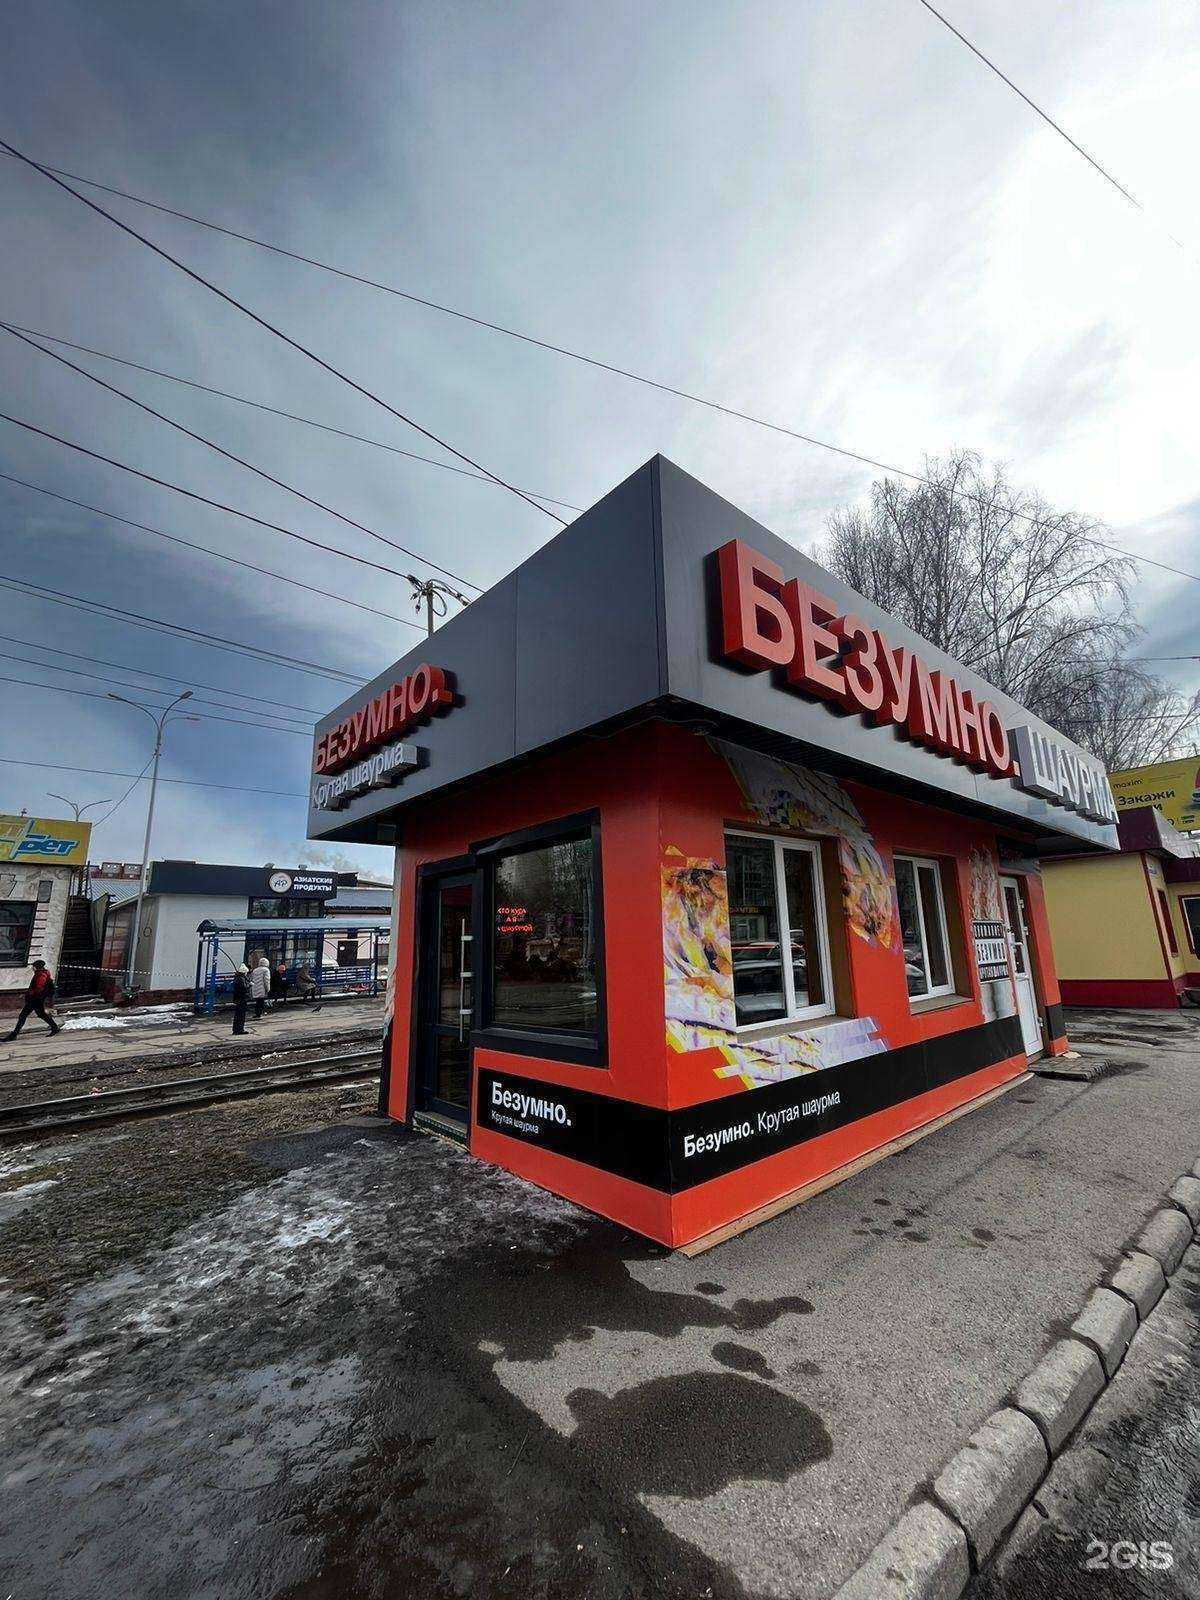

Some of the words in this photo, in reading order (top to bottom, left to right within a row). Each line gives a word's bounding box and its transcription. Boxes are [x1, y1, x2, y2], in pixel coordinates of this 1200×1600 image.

[728, 538, 1020, 776] БЕЗУМНО.
[313, 662, 444, 774] БЕЗУМНО.
[351, 743, 408, 786] шаурма
[1117, 789, 1176, 806] Закажи
[293, 876, 333, 885] АЗИАТСКИЕ
[293, 884, 332, 892] ПРОДУКТЫ
[491, 1081, 573, 1127] Безумно.
[491, 1110, 513, 1125] Крутая
[513, 1118, 540, 1134] шаурма
[683, 1120, 755, 1158] Безумно.
[757, 1105, 800, 1133] Крутая
[802, 1090, 842, 1116] шаурма
